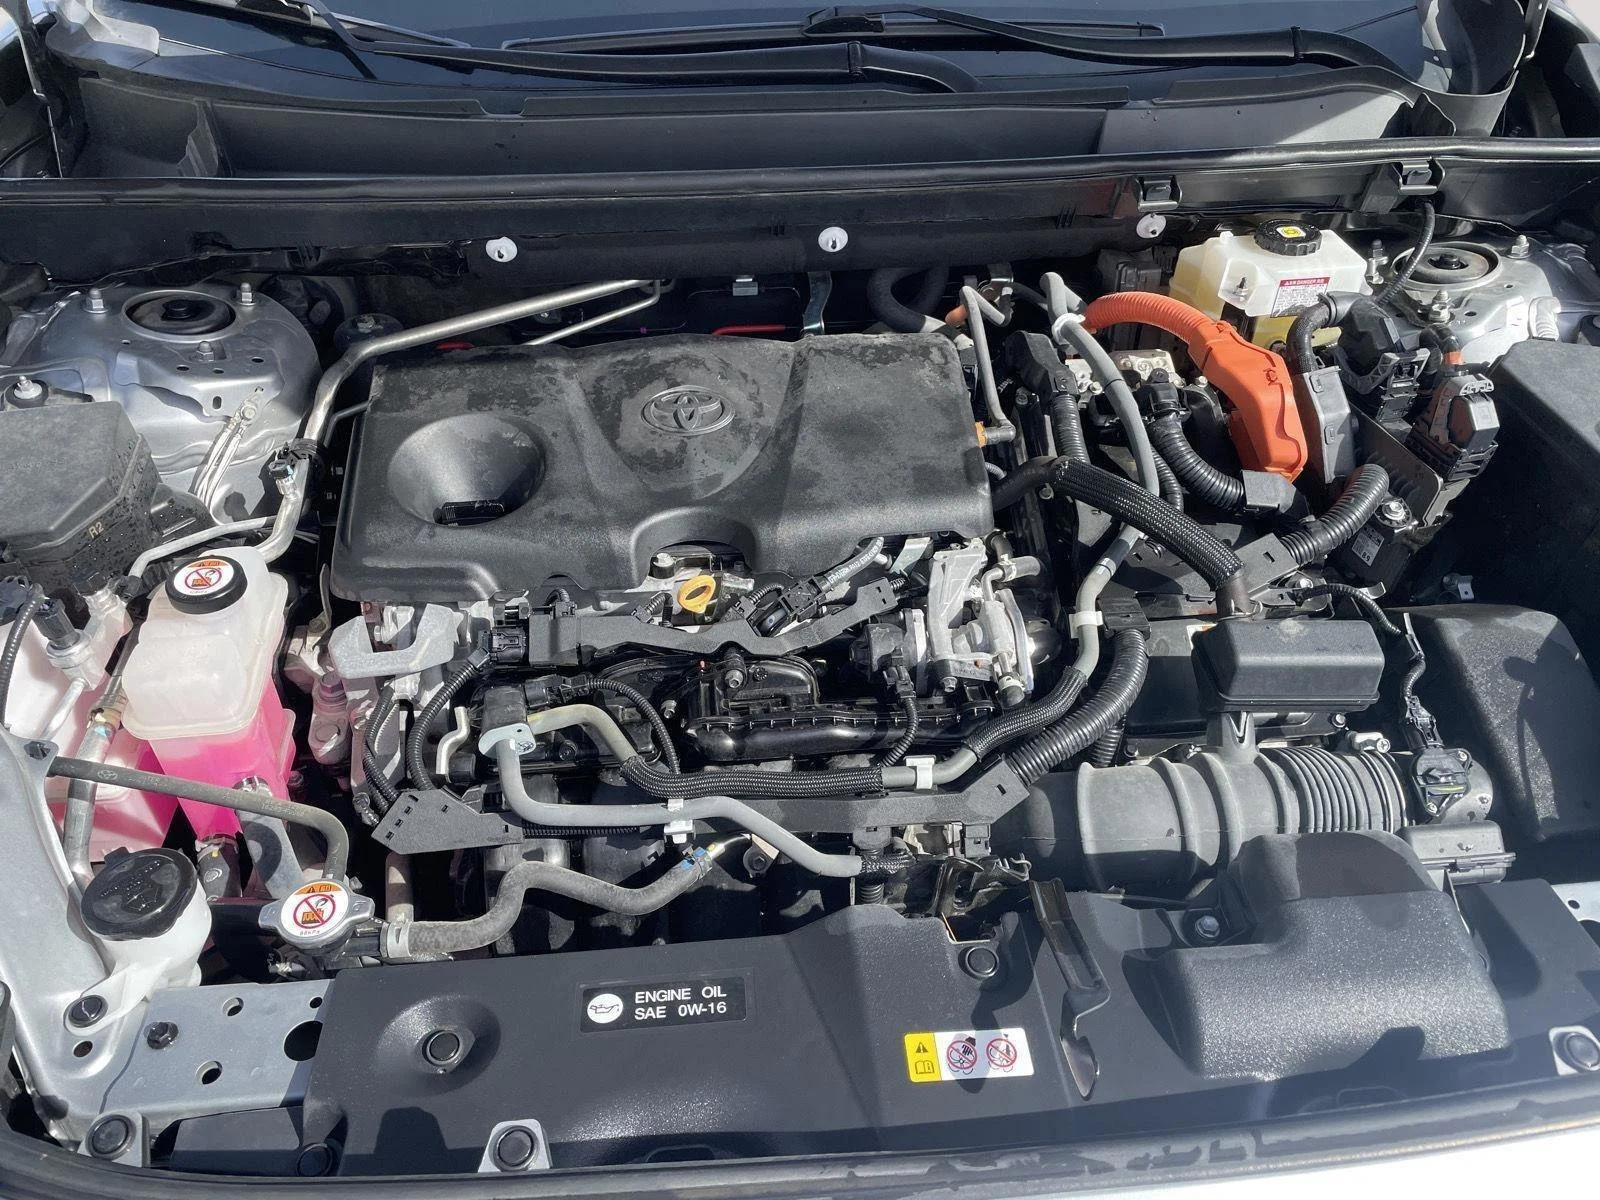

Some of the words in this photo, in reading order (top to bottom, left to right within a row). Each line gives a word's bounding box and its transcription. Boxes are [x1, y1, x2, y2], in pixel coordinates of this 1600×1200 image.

[88, 521, 104, 539] R2
[634, 987, 692, 1004] ENGINE
[701, 985, 727, 999] OIL
[634, 1005, 667, 1021] SAE
[678, 1001, 727, 1017] 0W-16
